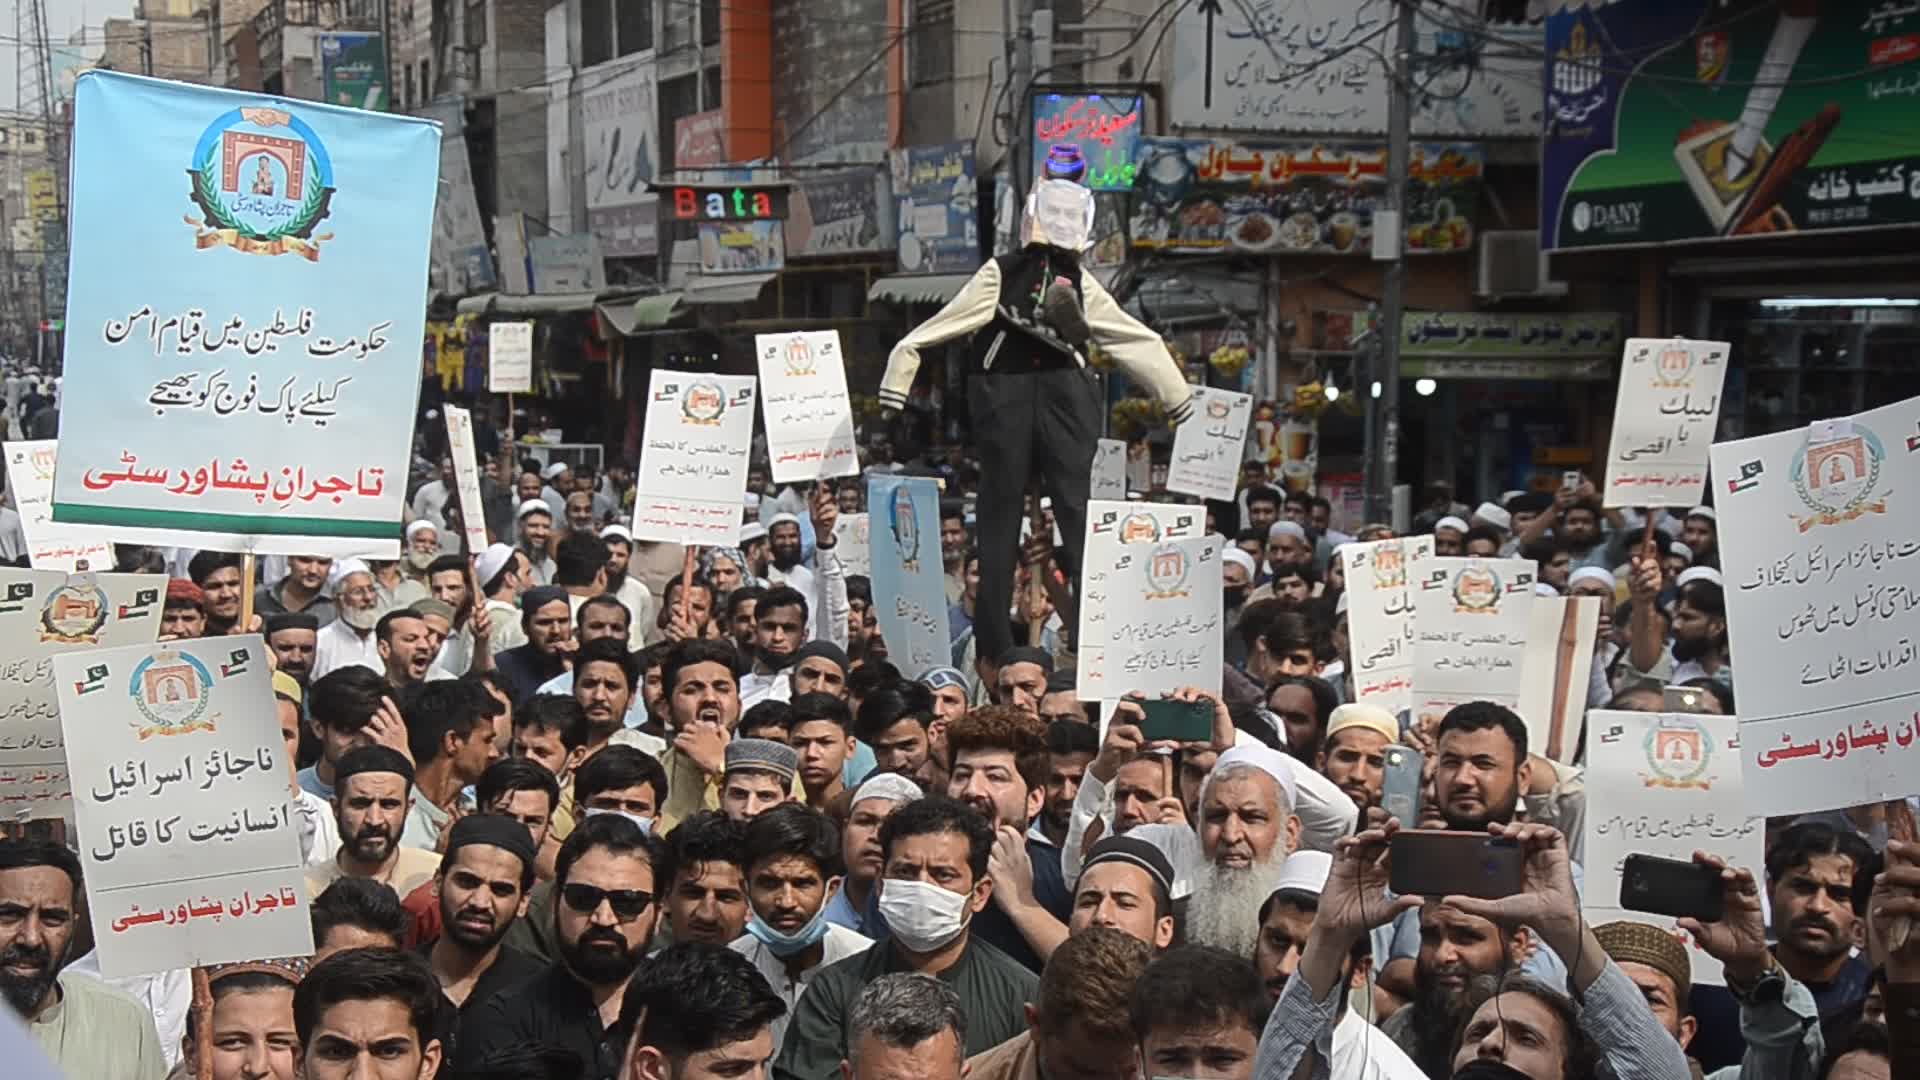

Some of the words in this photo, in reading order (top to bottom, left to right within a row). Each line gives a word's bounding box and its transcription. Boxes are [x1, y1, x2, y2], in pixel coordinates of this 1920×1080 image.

[674, 187, 772, 219] Bata
[1856, 165, 1906, 205] کتب
[1592, 202, 1645, 227] DANY
[105, 307, 158, 342] امن
[157, 310, 203, 354] قیام
[203, 314, 243, 352] میں
[245, 309, 313, 355] فلسطین
[309, 321, 392, 359] حکومت
[192, 369, 226, 408] کو
[214, 375, 257, 415] فوج
[257, 376, 296, 424] پاک
[299, 376, 352, 426] کیلئے
[1677, 424, 1689, 447] یا
[83, 449, 168, 490] سٹی
[167, 456, 270, 503] پشاور
[1739, 552, 1796, 590] کیخلاف
[1795, 544, 1853, 584] اسرائیل
[1853, 541, 1895, 570] ناجائز
[1778, 602, 1817, 640] ٹھوس
[1814, 604, 1841, 633] میں
[1842, 584, 1886, 627] کونسل
[1800, 654, 1853, 685] اٹھائے
[1853, 639, 1918, 675] اقدامات
[1757, 731, 1822, 768] سٹی
[1821, 719, 1890, 760] پشاور
[92, 755, 194, 802] اسرائیل
[199, 747, 273, 789] ناجائز
[92, 820, 148, 861] قاتل
[154, 815, 181, 843] کا
[188, 803, 289, 842] انسانیت
[1597, 815, 1623, 834] امن
[1622, 815, 1649, 840] قیام
[1648, 819, 1671, 838] میں
[1671, 812, 1716, 839] فلسطین
[1709, 816, 1765, 840] حکومت
[111, 904, 166, 932] سٹی
[163, 895, 224, 926] پشاور
[228, 887, 297, 917] تاجران
